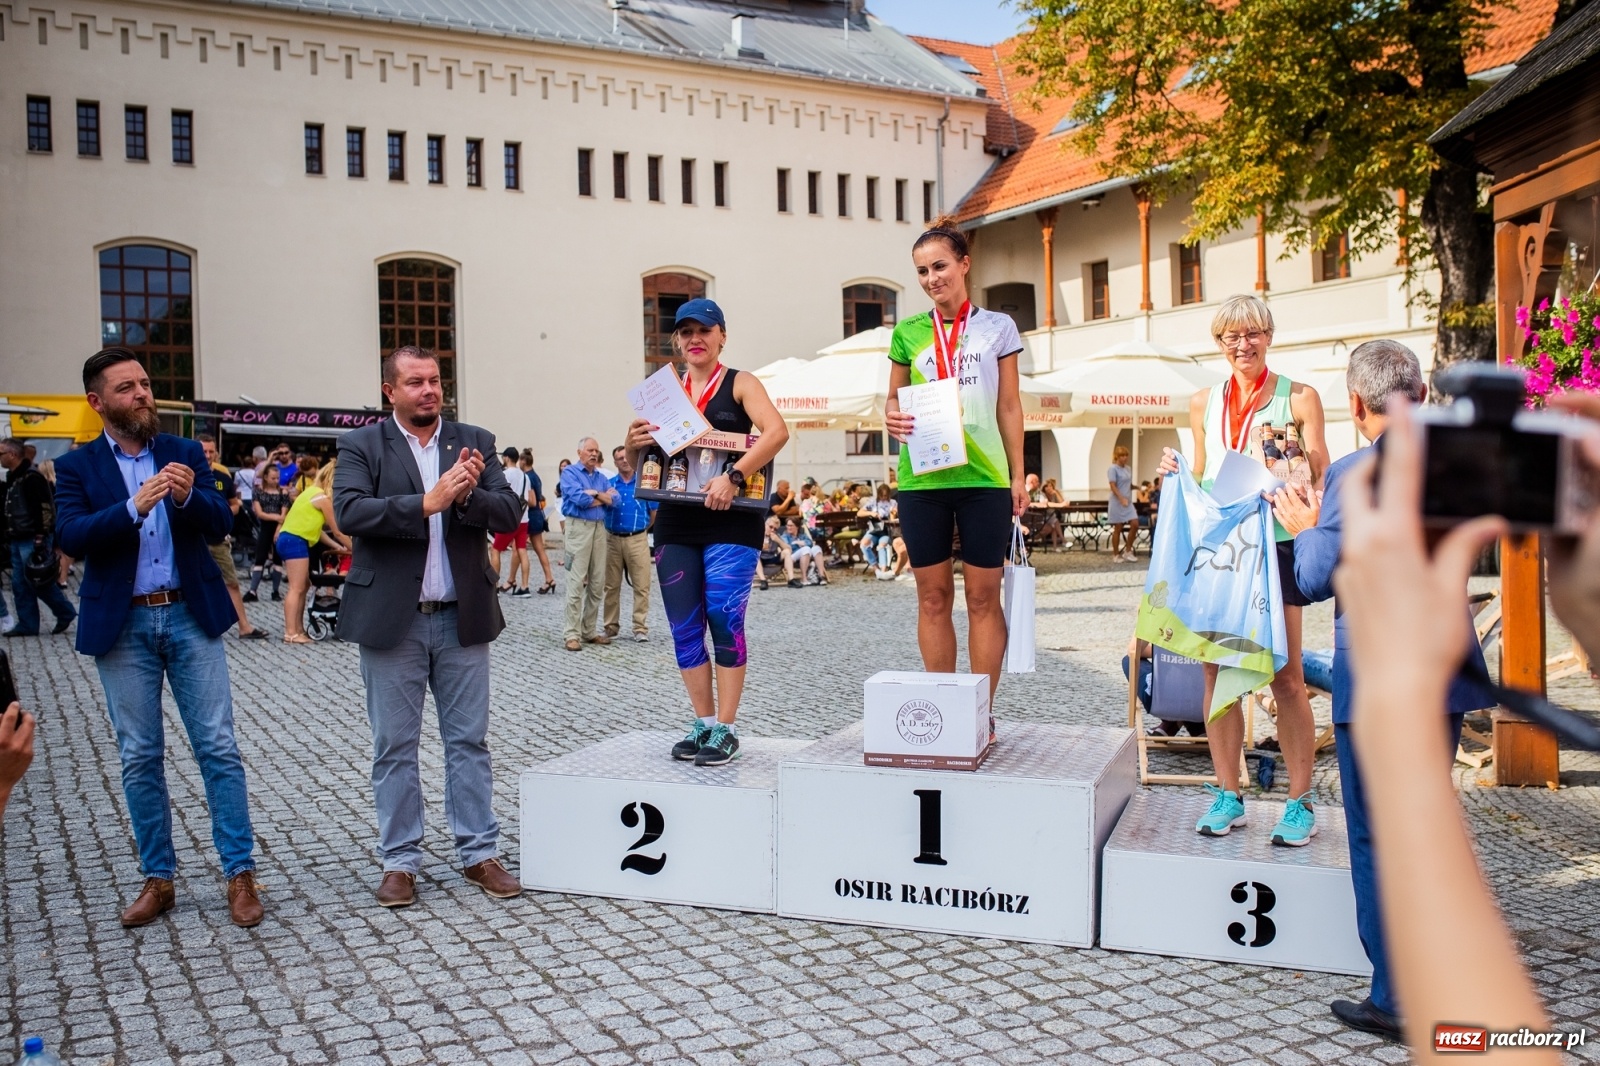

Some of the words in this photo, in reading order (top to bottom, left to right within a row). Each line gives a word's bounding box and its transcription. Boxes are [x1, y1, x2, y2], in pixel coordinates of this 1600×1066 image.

[926, 352, 981, 366] AYWNI
[776, 397, 829, 410] RACIBORSKIE
[1091, 395, 1170, 406] RACIBORSKIE
[222, 409, 272, 423] SLOW
[285, 412, 320, 425] BBQ
[620, 801, 667, 875] 2
[913, 789, 948, 866] 1
[834, 877, 893, 901] OSIR
[901, 883, 1031, 915] RACIBÓRZ
[1227, 881, 1276, 948] 3
